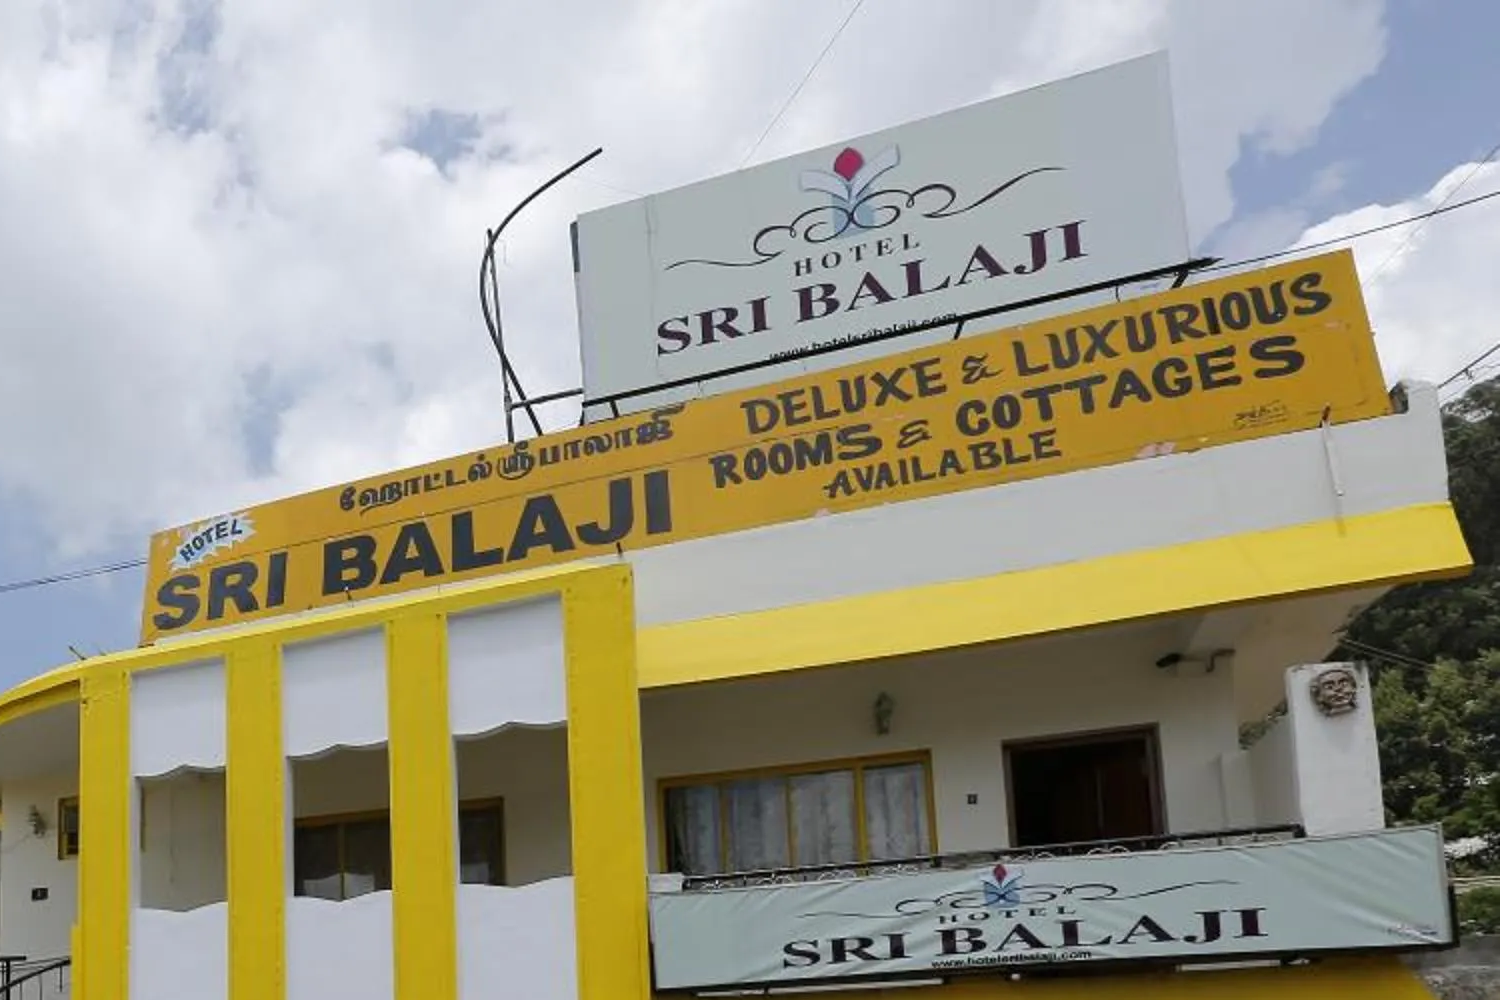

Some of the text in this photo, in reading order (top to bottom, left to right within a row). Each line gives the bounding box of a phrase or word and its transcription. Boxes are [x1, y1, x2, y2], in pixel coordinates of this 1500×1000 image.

[656, 219, 1090, 357] SRI BALAJI
[793, 233, 921, 277] HOTEL
[740, 272, 1333, 435] DELUXE & LUXURIOUS
[710, 422, 884, 489] ROOMS
[895, 419, 932, 449] &
[955, 335, 1306, 438] COTTAGES
[823, 429, 1062, 499] AVAILABLE
[154, 469, 672, 630] SRI BALAJI
[181, 517, 244, 563] HOTEL
[782, 907, 1269, 969] SRI BALAJI
[939, 905, 1073, 925] HOTEL
